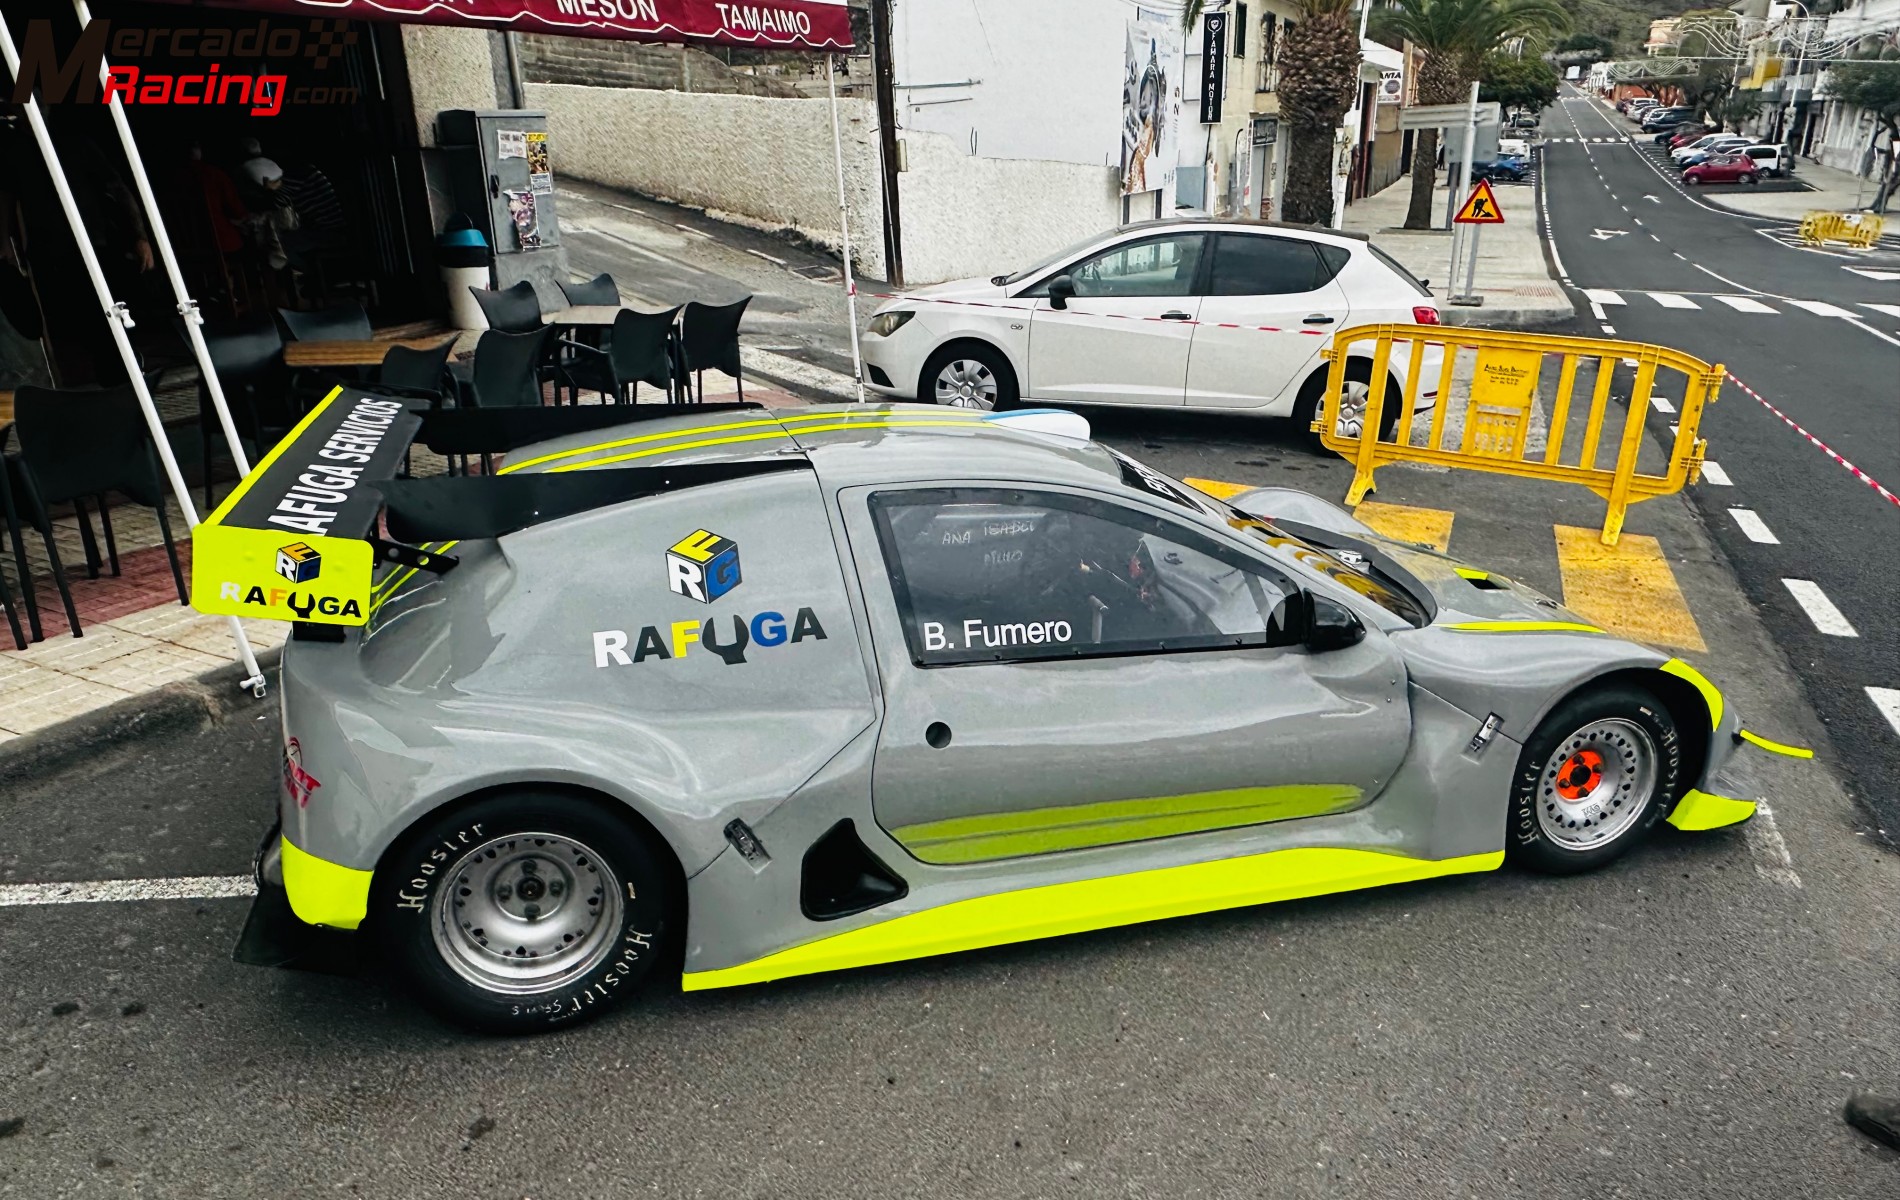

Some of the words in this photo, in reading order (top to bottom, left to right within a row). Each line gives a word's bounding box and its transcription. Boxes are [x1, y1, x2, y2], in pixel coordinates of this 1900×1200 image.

[715, 3, 811, 35] TAMAIMO
[268, 464, 364, 536] AFUGA
[318, 398, 402, 463] SERVICIOS
[942, 530, 971, 545] ANA
[220, 581, 362, 619] RAFUGA
[593, 607, 828, 668] RAFUGA
[923, 622, 955, 651] B.
[963, 619, 1072, 648] Fumero
